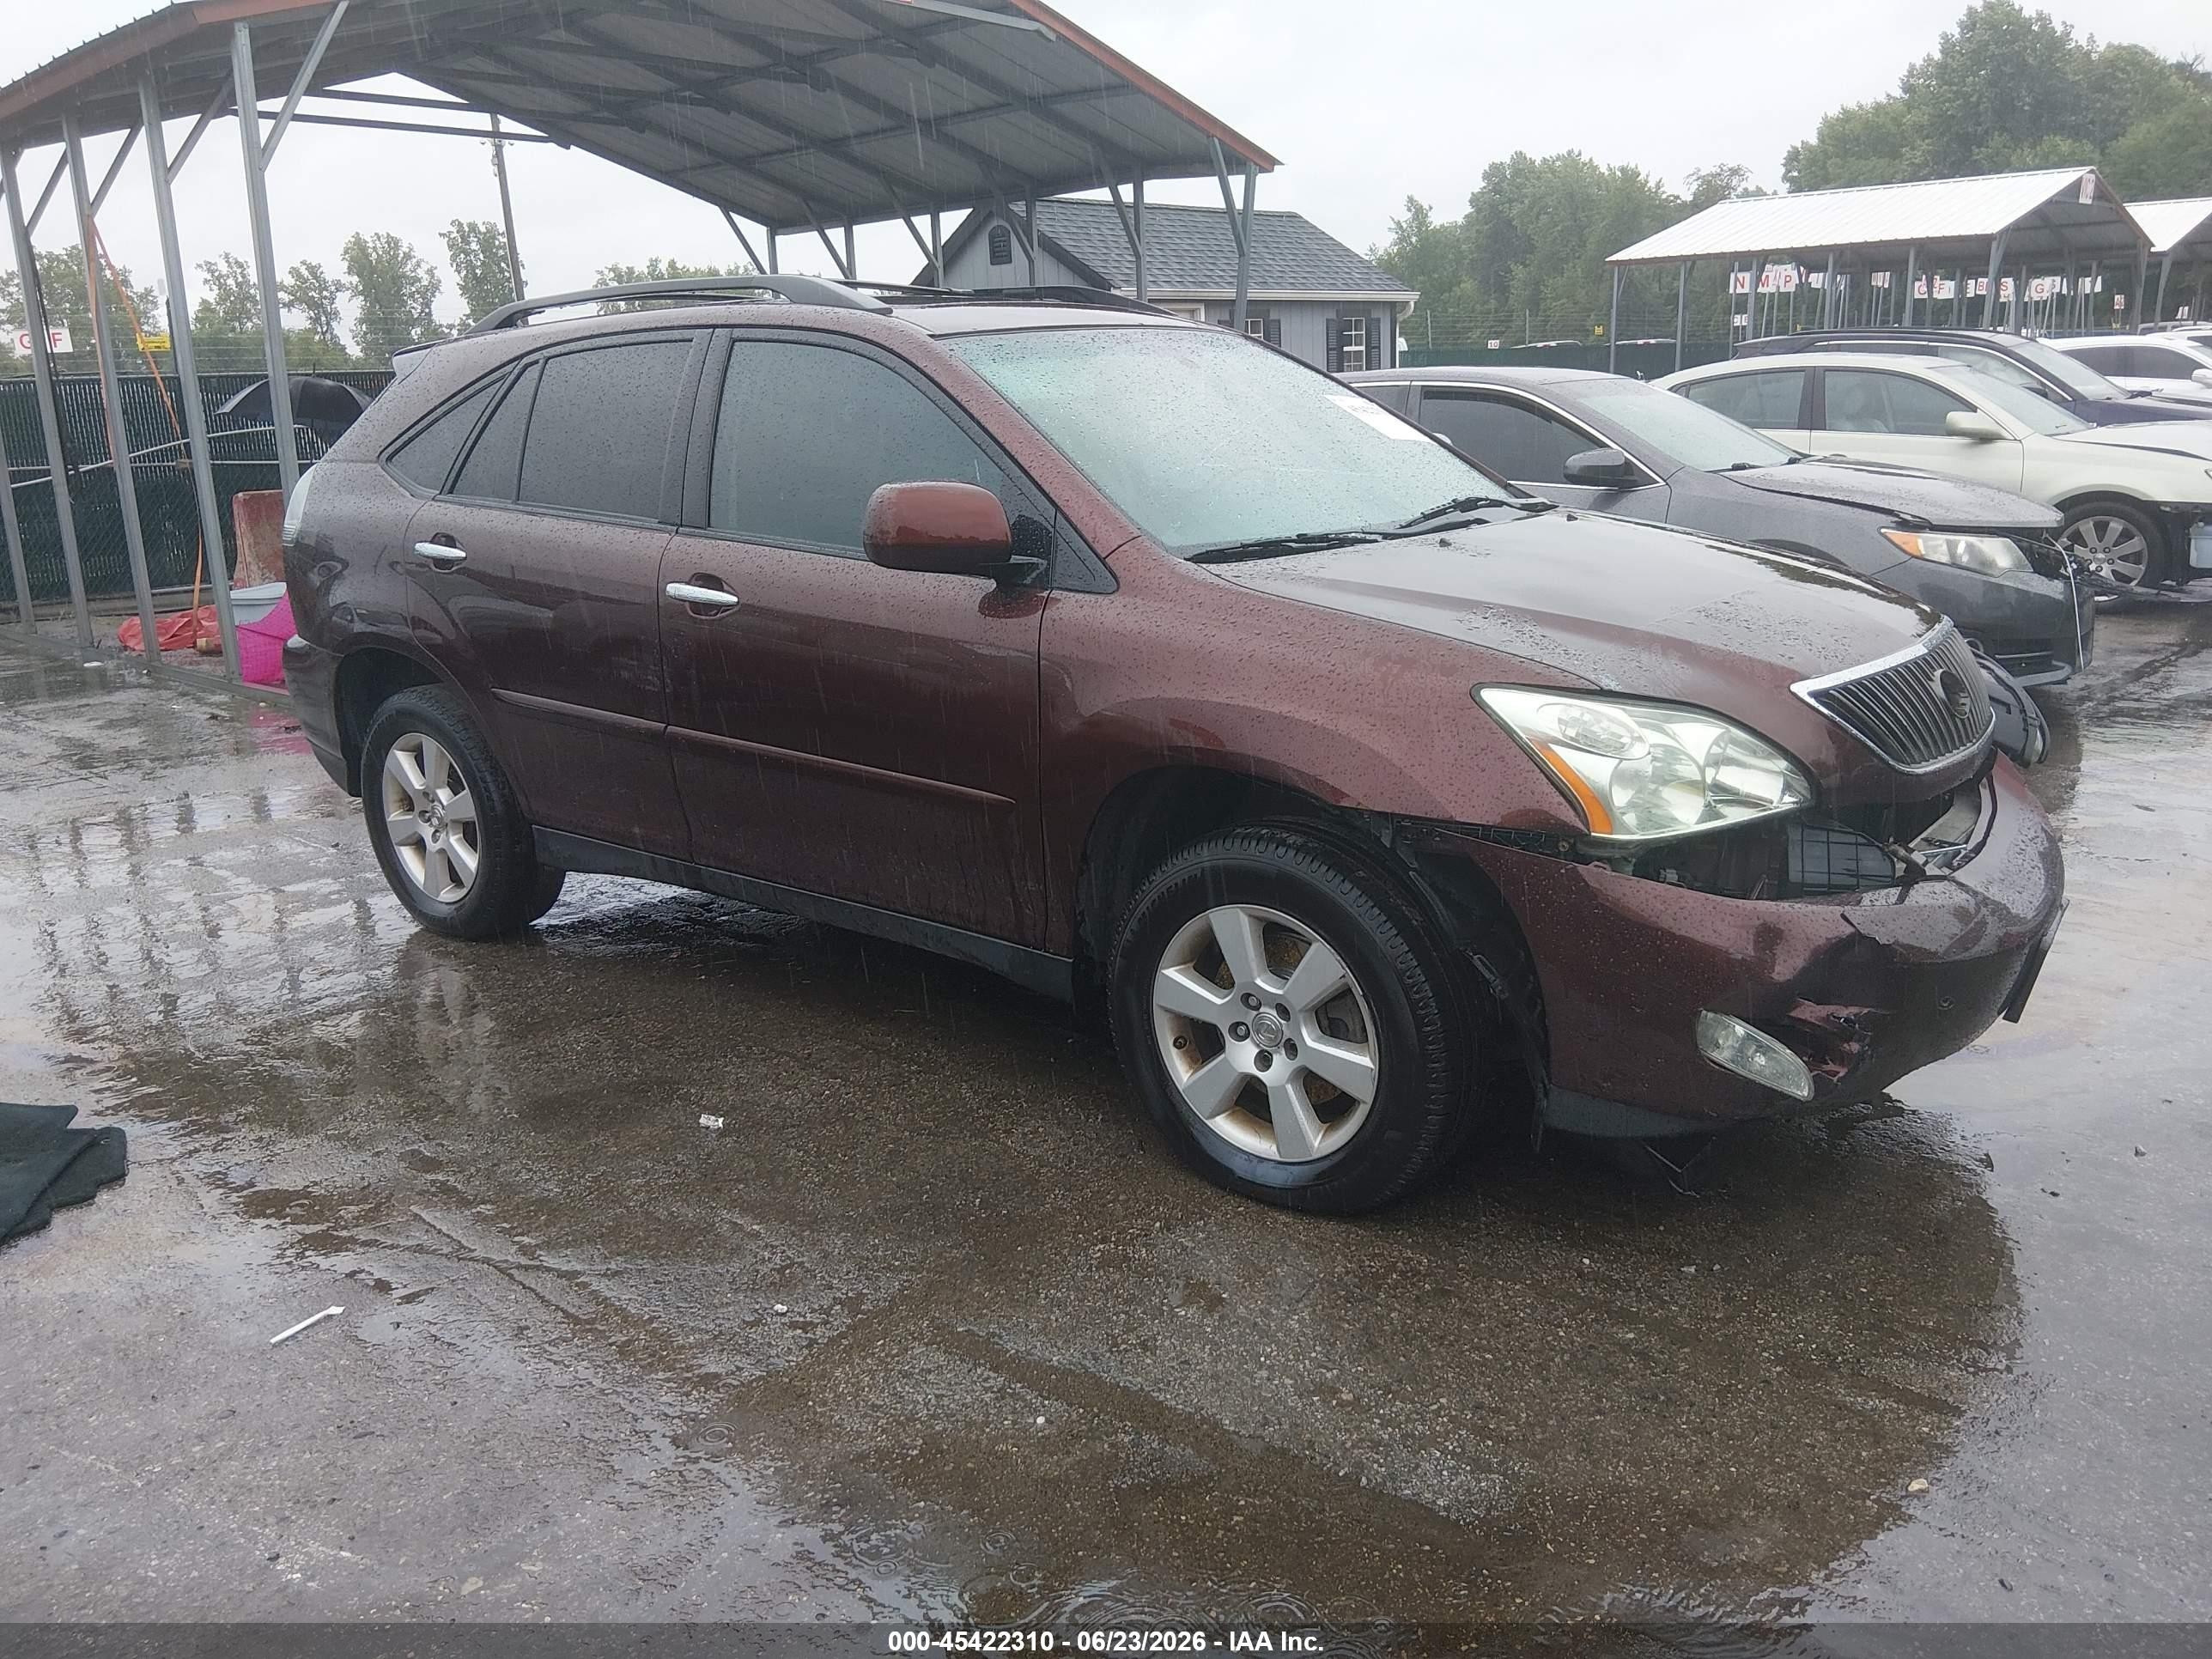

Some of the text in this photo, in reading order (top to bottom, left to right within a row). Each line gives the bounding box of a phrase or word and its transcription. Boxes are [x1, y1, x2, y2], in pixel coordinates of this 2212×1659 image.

[1784, 275, 1792, 289] P
[2000, 281, 2008, 292] S
[1937, 283, 1945, 295] F
[2034, 283, 2045, 295] G
[51, 331, 63, 349] F
